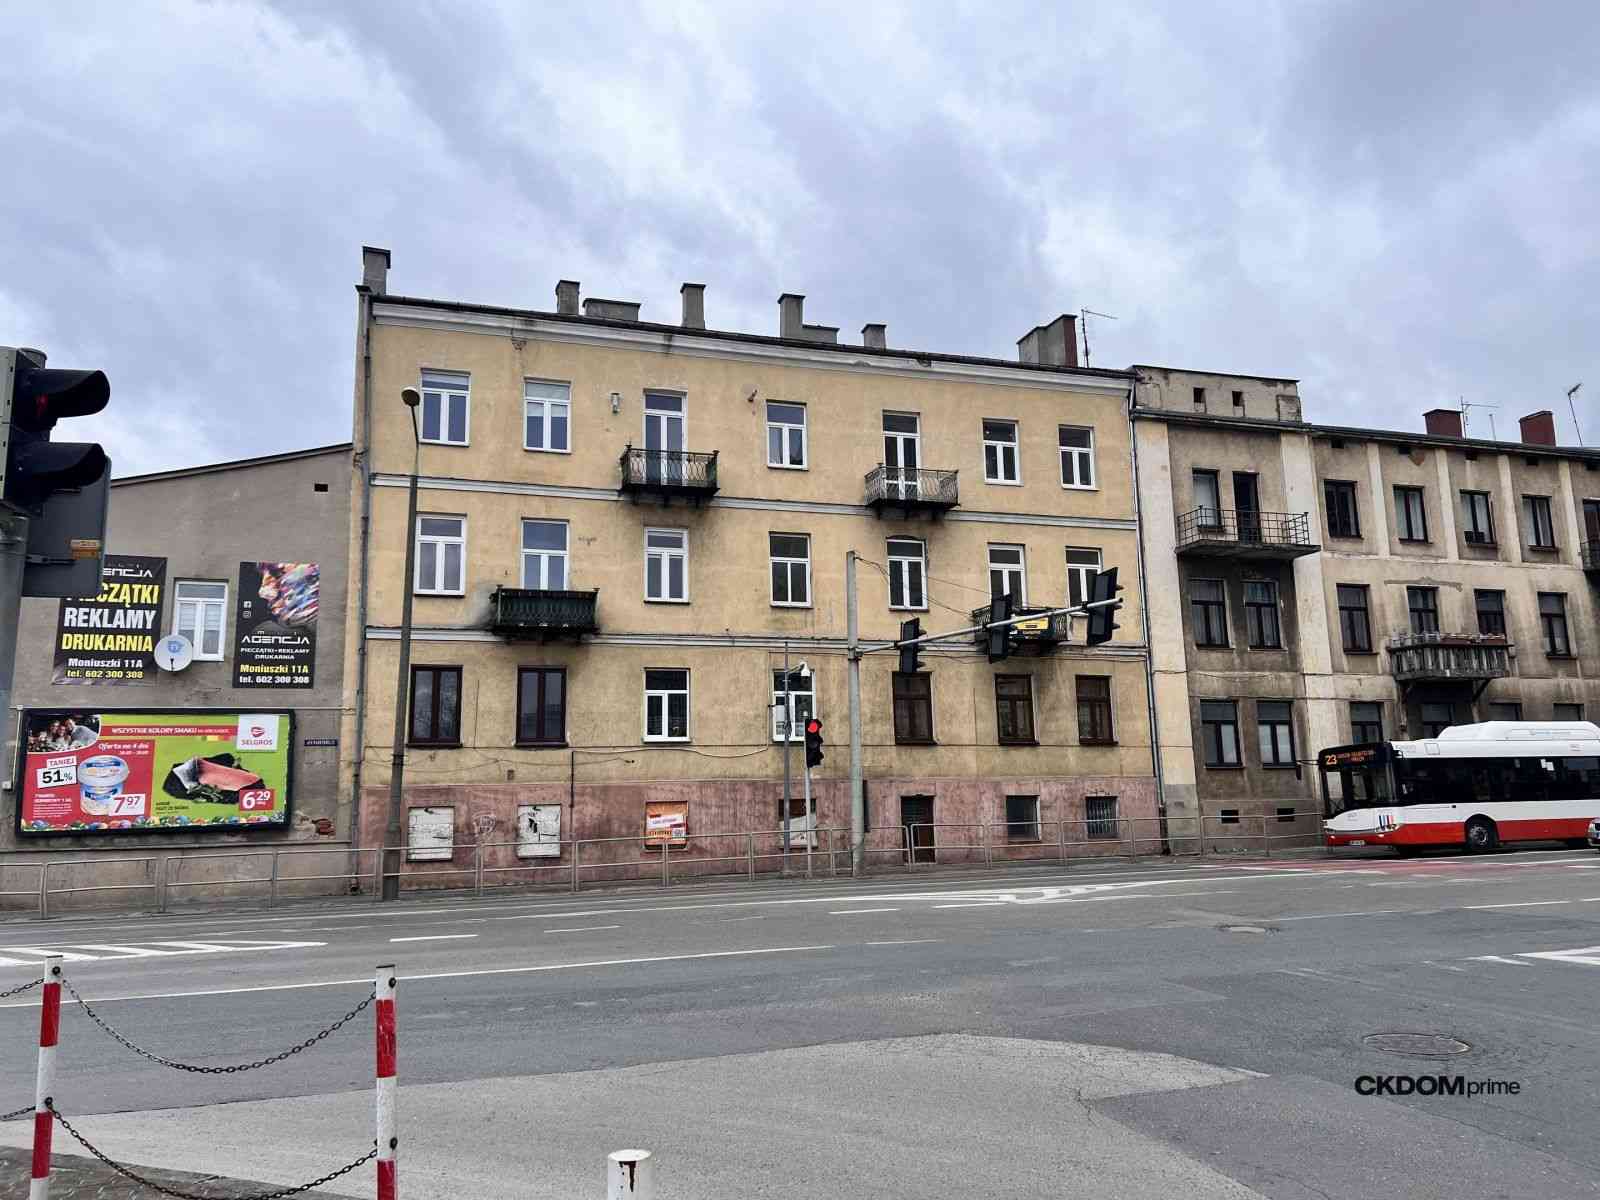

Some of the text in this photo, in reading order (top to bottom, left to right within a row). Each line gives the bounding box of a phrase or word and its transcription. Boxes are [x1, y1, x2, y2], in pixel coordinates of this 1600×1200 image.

[102, 567, 153, 578] ENCJA
[66, 582, 160, 608] CZĄTKI
[64, 607, 156, 629] REKLAMY
[62, 633, 153, 652] DRUKARNIA
[241, 635, 310, 644] AGENCJA
[68, 658, 143, 668] Moniuszki 11A
[240, 664, 309, 673] Moniuszki 11A
[67, 669, 82, 678] tel.
[85, 670, 103, 679] 602
[105, 670, 123, 679] 300
[1325, 753, 1337, 765] 23
